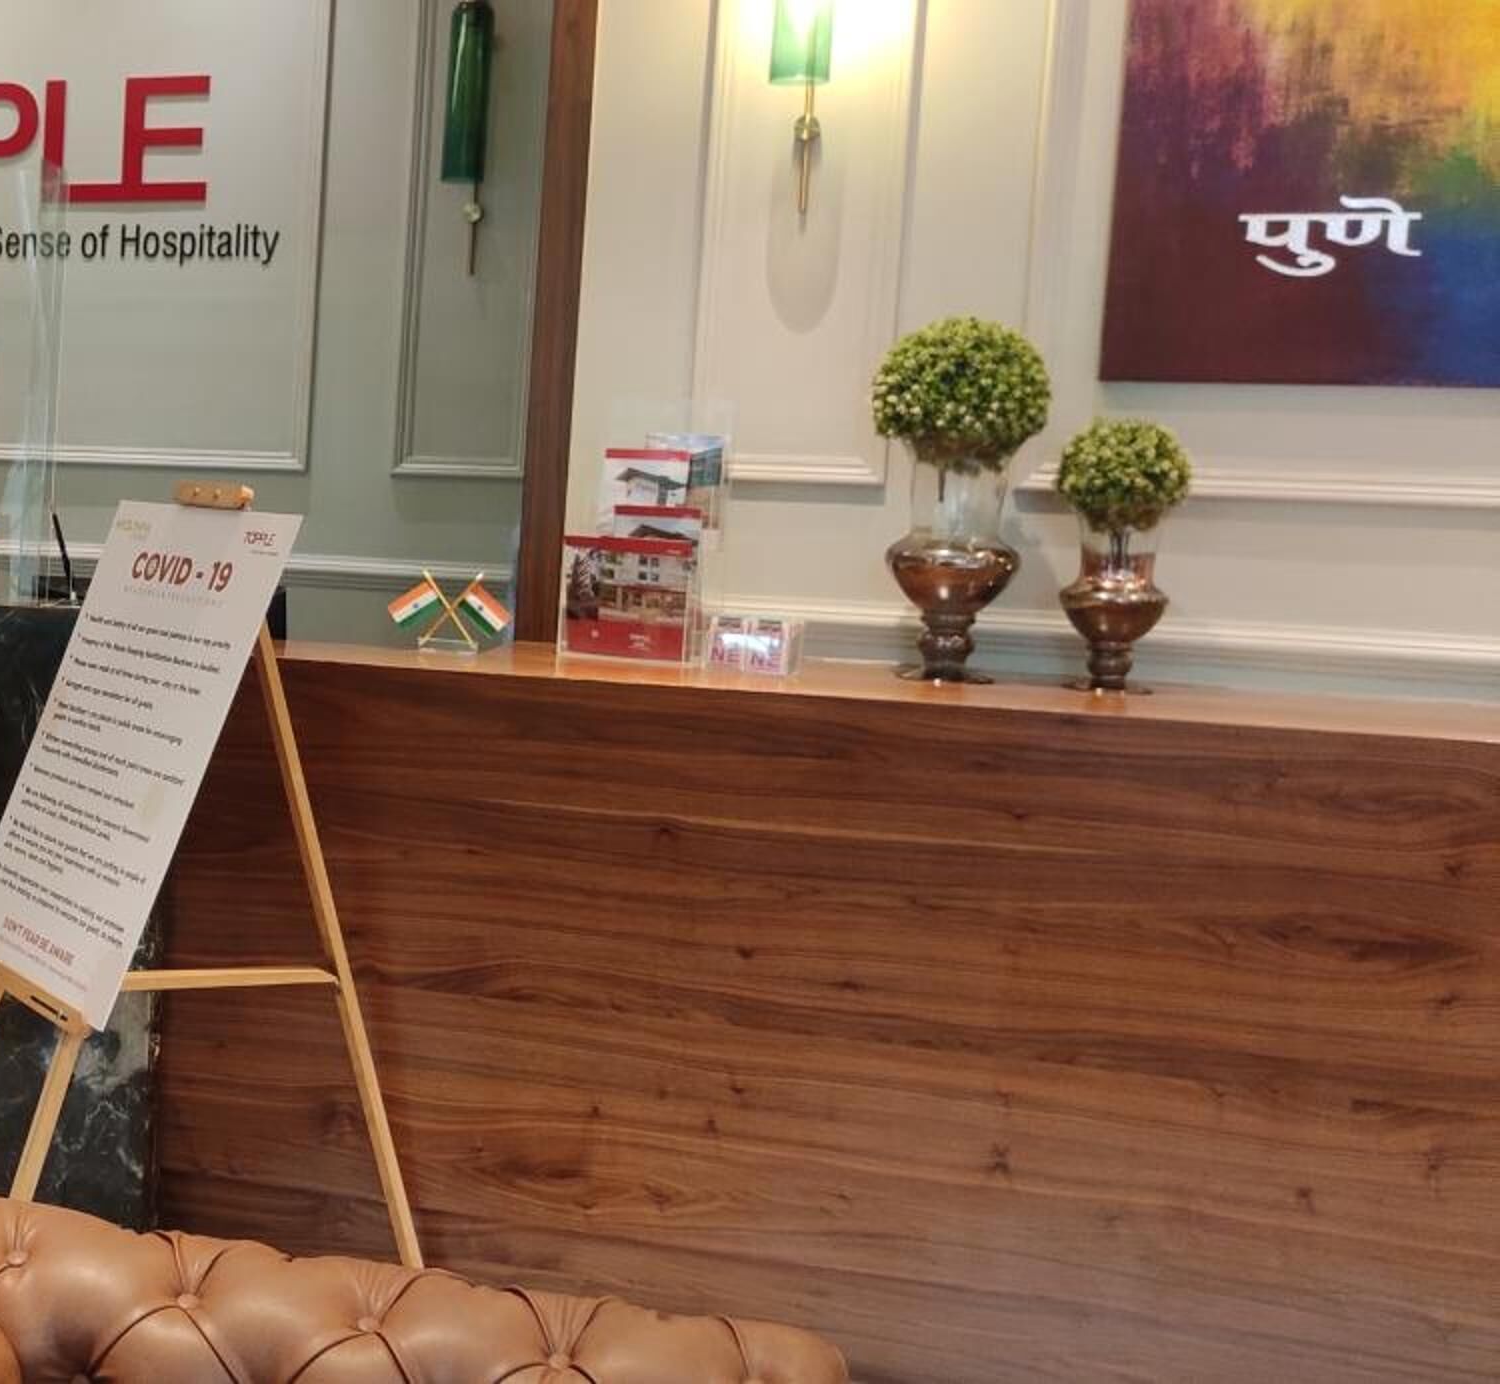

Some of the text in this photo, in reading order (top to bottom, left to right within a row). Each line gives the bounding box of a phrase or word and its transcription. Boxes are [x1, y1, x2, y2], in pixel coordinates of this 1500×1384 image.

[81, 223, 110, 258] of
[120, 223, 280, 266] Hospitality
[1238, 195, 1423, 277] पुणे
[132, 551, 193, 586] COVID
[208, 561, 233, 593] 19
